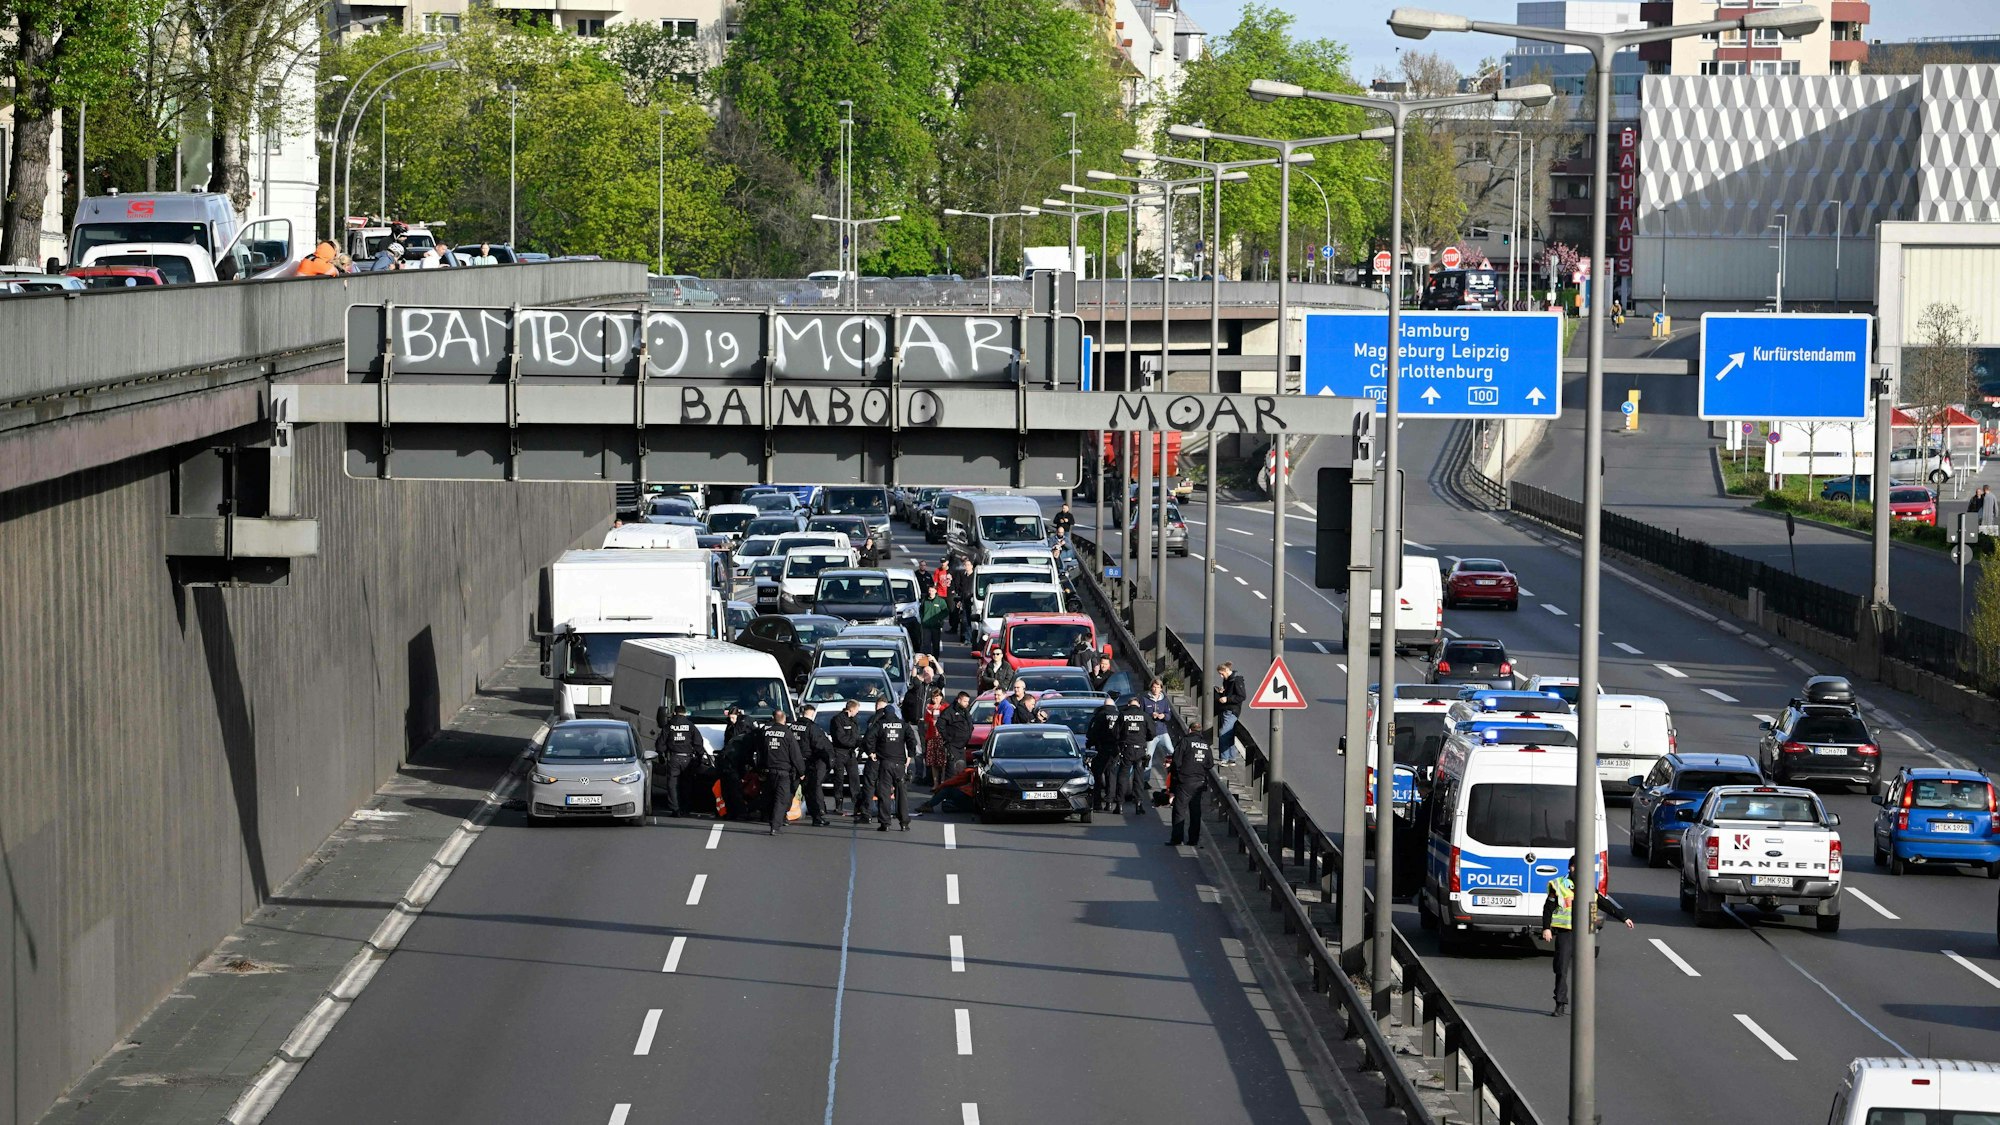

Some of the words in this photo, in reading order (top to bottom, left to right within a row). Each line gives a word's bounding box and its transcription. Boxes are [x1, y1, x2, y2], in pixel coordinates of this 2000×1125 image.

[1619, 132, 1634, 273] BAUHAUS
[1443, 254, 1459, 263] STOP
[704, 329, 739, 368] 19
[774, 314, 1019, 378] MOAR
[1354, 343, 1444, 361] Mageburg
[1452, 344, 1509, 362] Leipzig
[1753, 346, 1856, 362] Kurfürstendamm
[1370, 364, 1493, 382] Chrlottenburg
[1473, 390, 1493, 401] 100
[680, 386, 944, 427] BAMBOO
[1109, 394, 1288, 433] MOAR
[765, 730, 785, 738] POLIZEI
[1721, 859, 1826, 869] RANGER
[1467, 873, 1522, 886] POLIZEI
[1490, 896, 1513, 905] 31906
